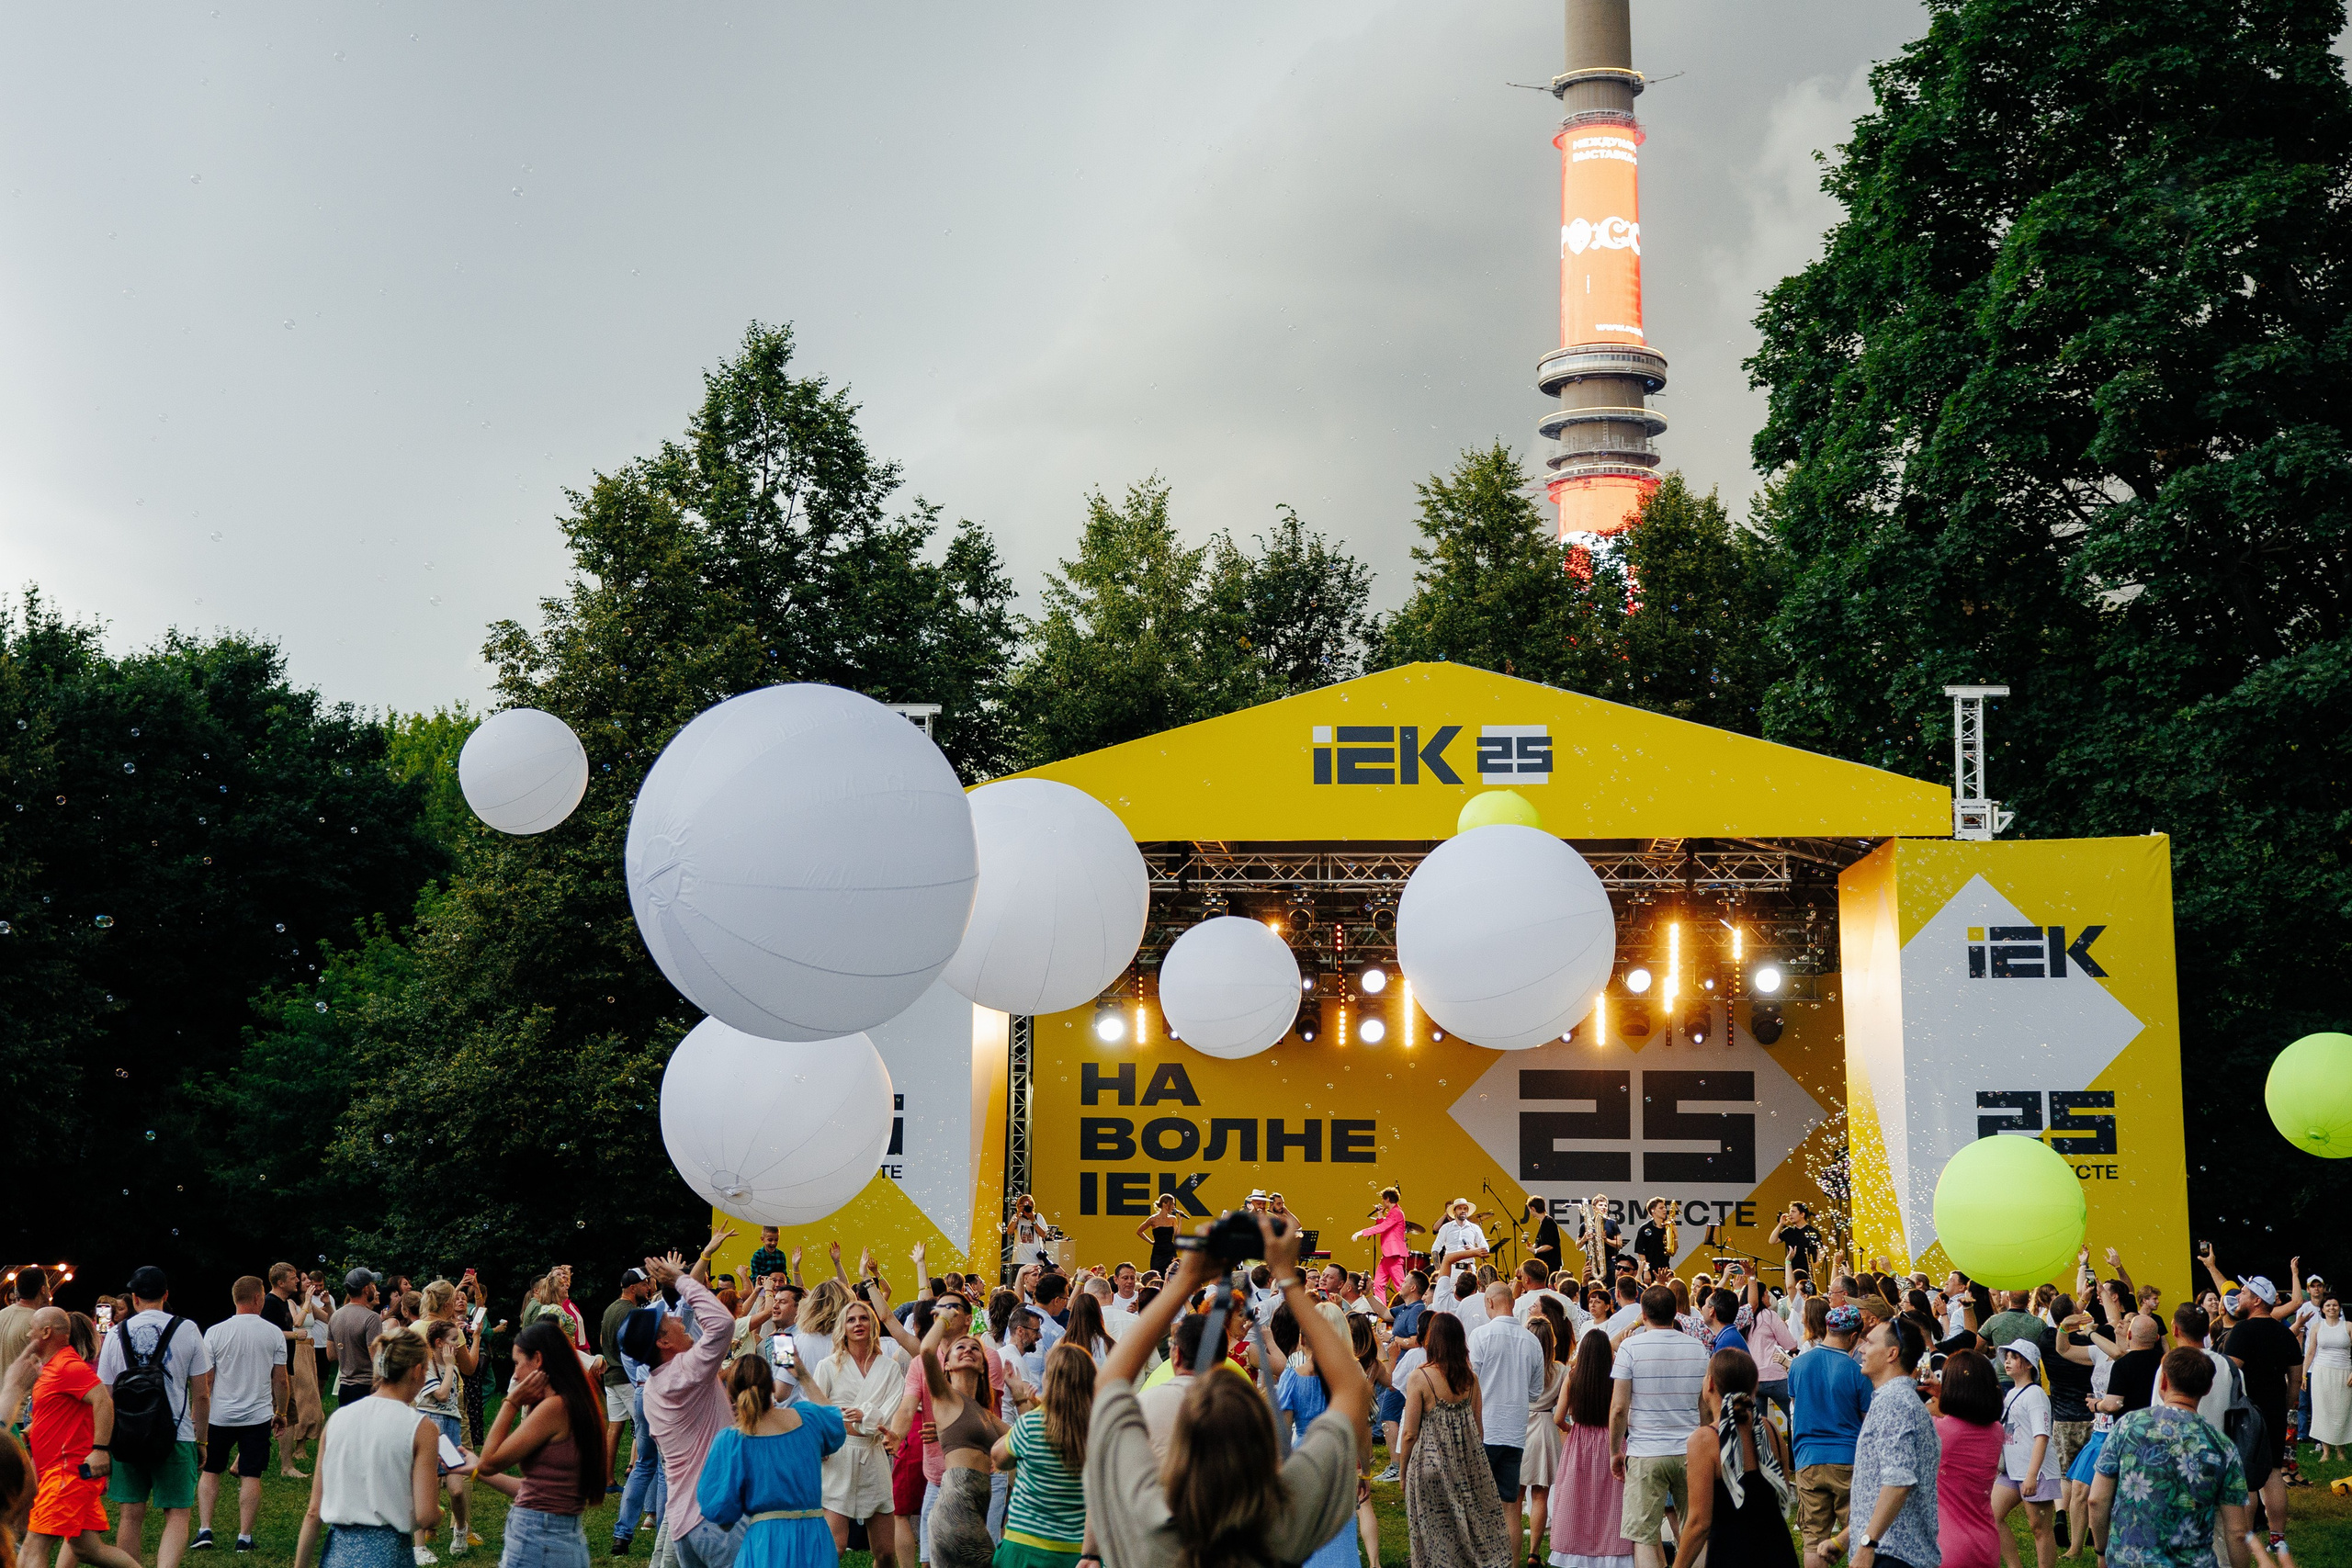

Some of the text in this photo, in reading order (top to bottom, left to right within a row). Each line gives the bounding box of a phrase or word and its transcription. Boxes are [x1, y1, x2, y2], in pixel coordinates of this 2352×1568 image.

[1476, 736, 1554, 773] 25
[1080, 1063, 1201, 1106] НА
[1080, 1117, 1376, 1163] ВОЛНЕ
[1520, 1069, 1756, 1183] 25
[1976, 1091, 2118, 1155] 25
[2069, 1164, 2119, 1179] СТЕ
[1080, 1172, 1213, 1216] IEK
